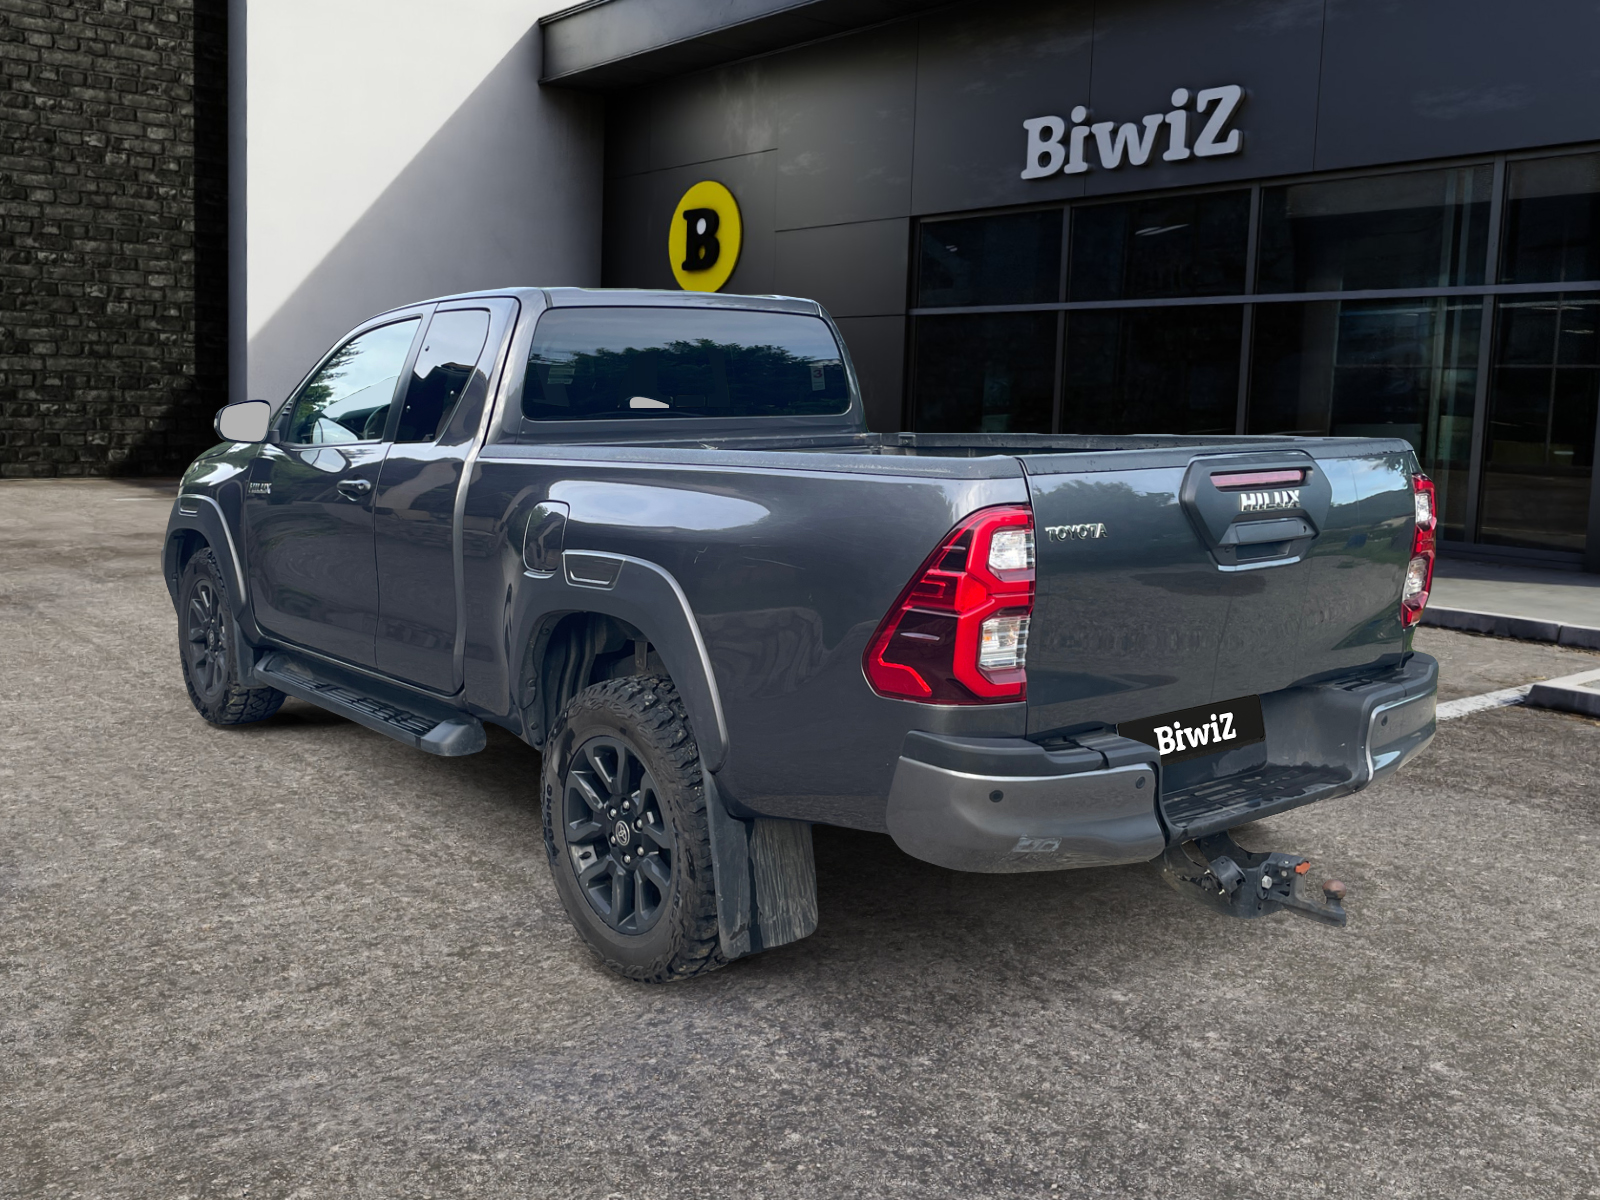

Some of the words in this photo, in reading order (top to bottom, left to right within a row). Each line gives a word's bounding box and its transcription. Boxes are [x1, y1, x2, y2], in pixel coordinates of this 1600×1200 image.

[1020, 84, 1244, 180] BiwiZ
[681, 207, 720, 272] B
[1239, 489, 1301, 512] HILUX
[1044, 522, 1109, 543] TOYOTA
[1153, 711, 1237, 756] BiwiZ
